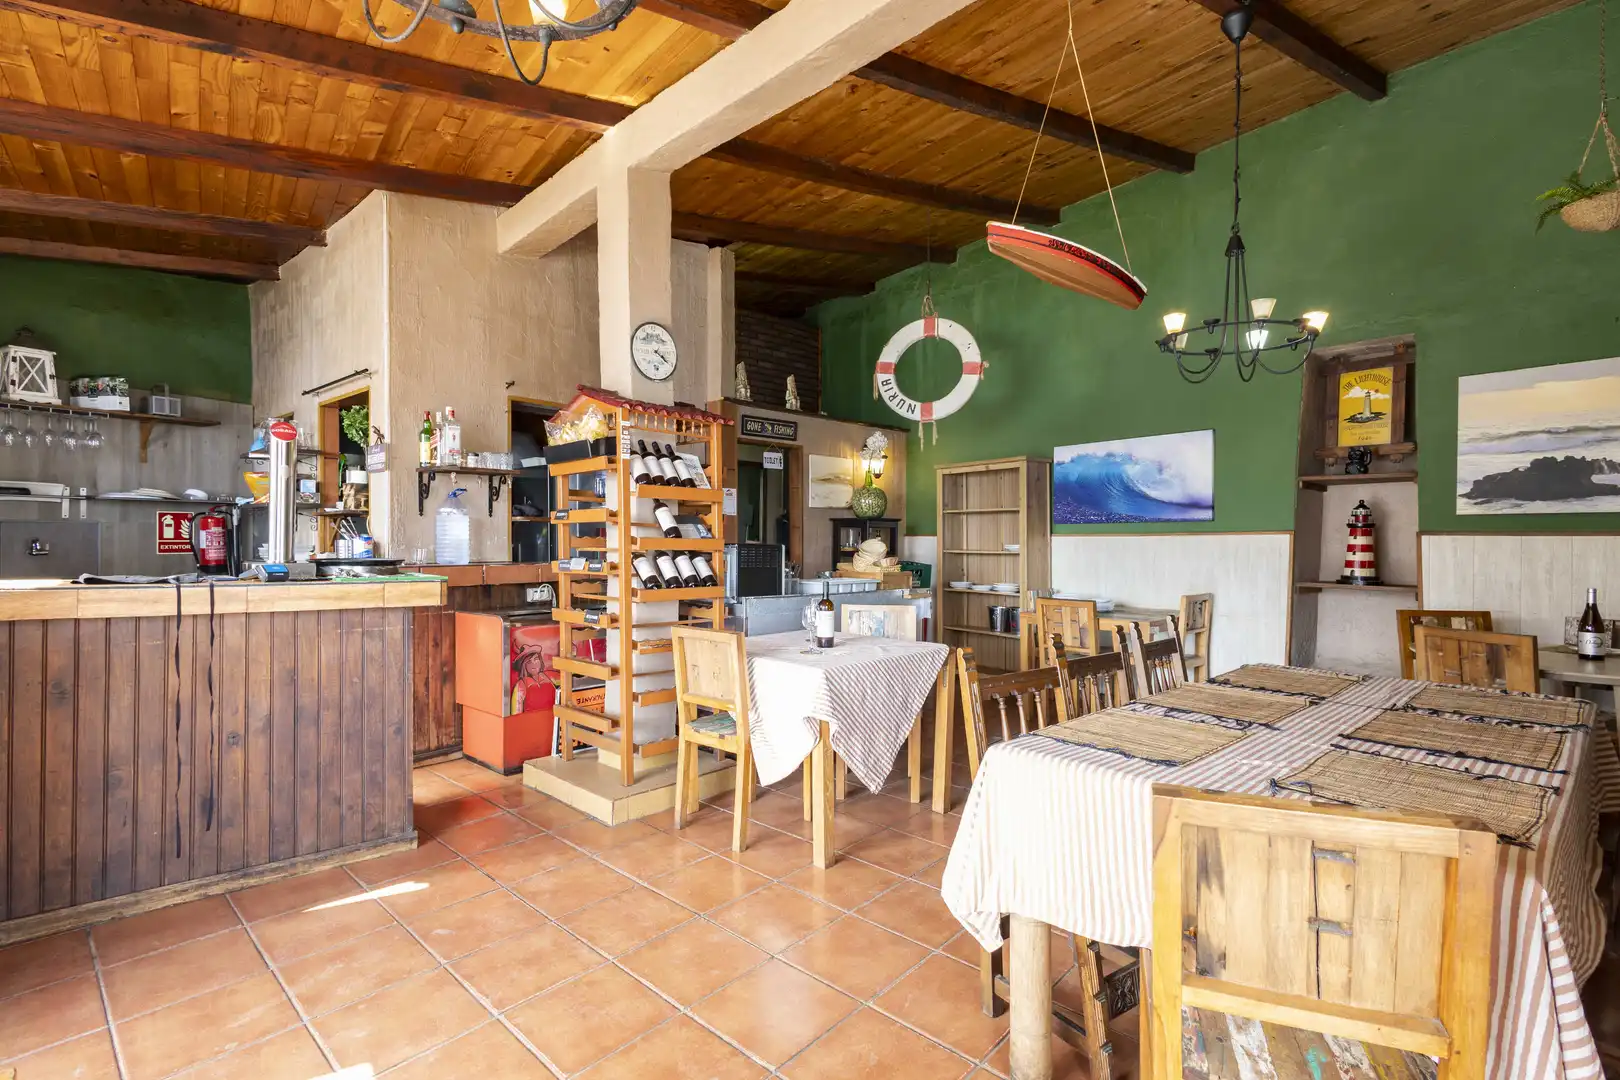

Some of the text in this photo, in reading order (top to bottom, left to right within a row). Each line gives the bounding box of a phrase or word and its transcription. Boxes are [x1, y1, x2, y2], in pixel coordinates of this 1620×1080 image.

[1354, 373, 1391, 386] LIGHTHOUSE
[881, 378, 917, 415] NURIA
[746, 421, 794, 436] GONE FISHING
